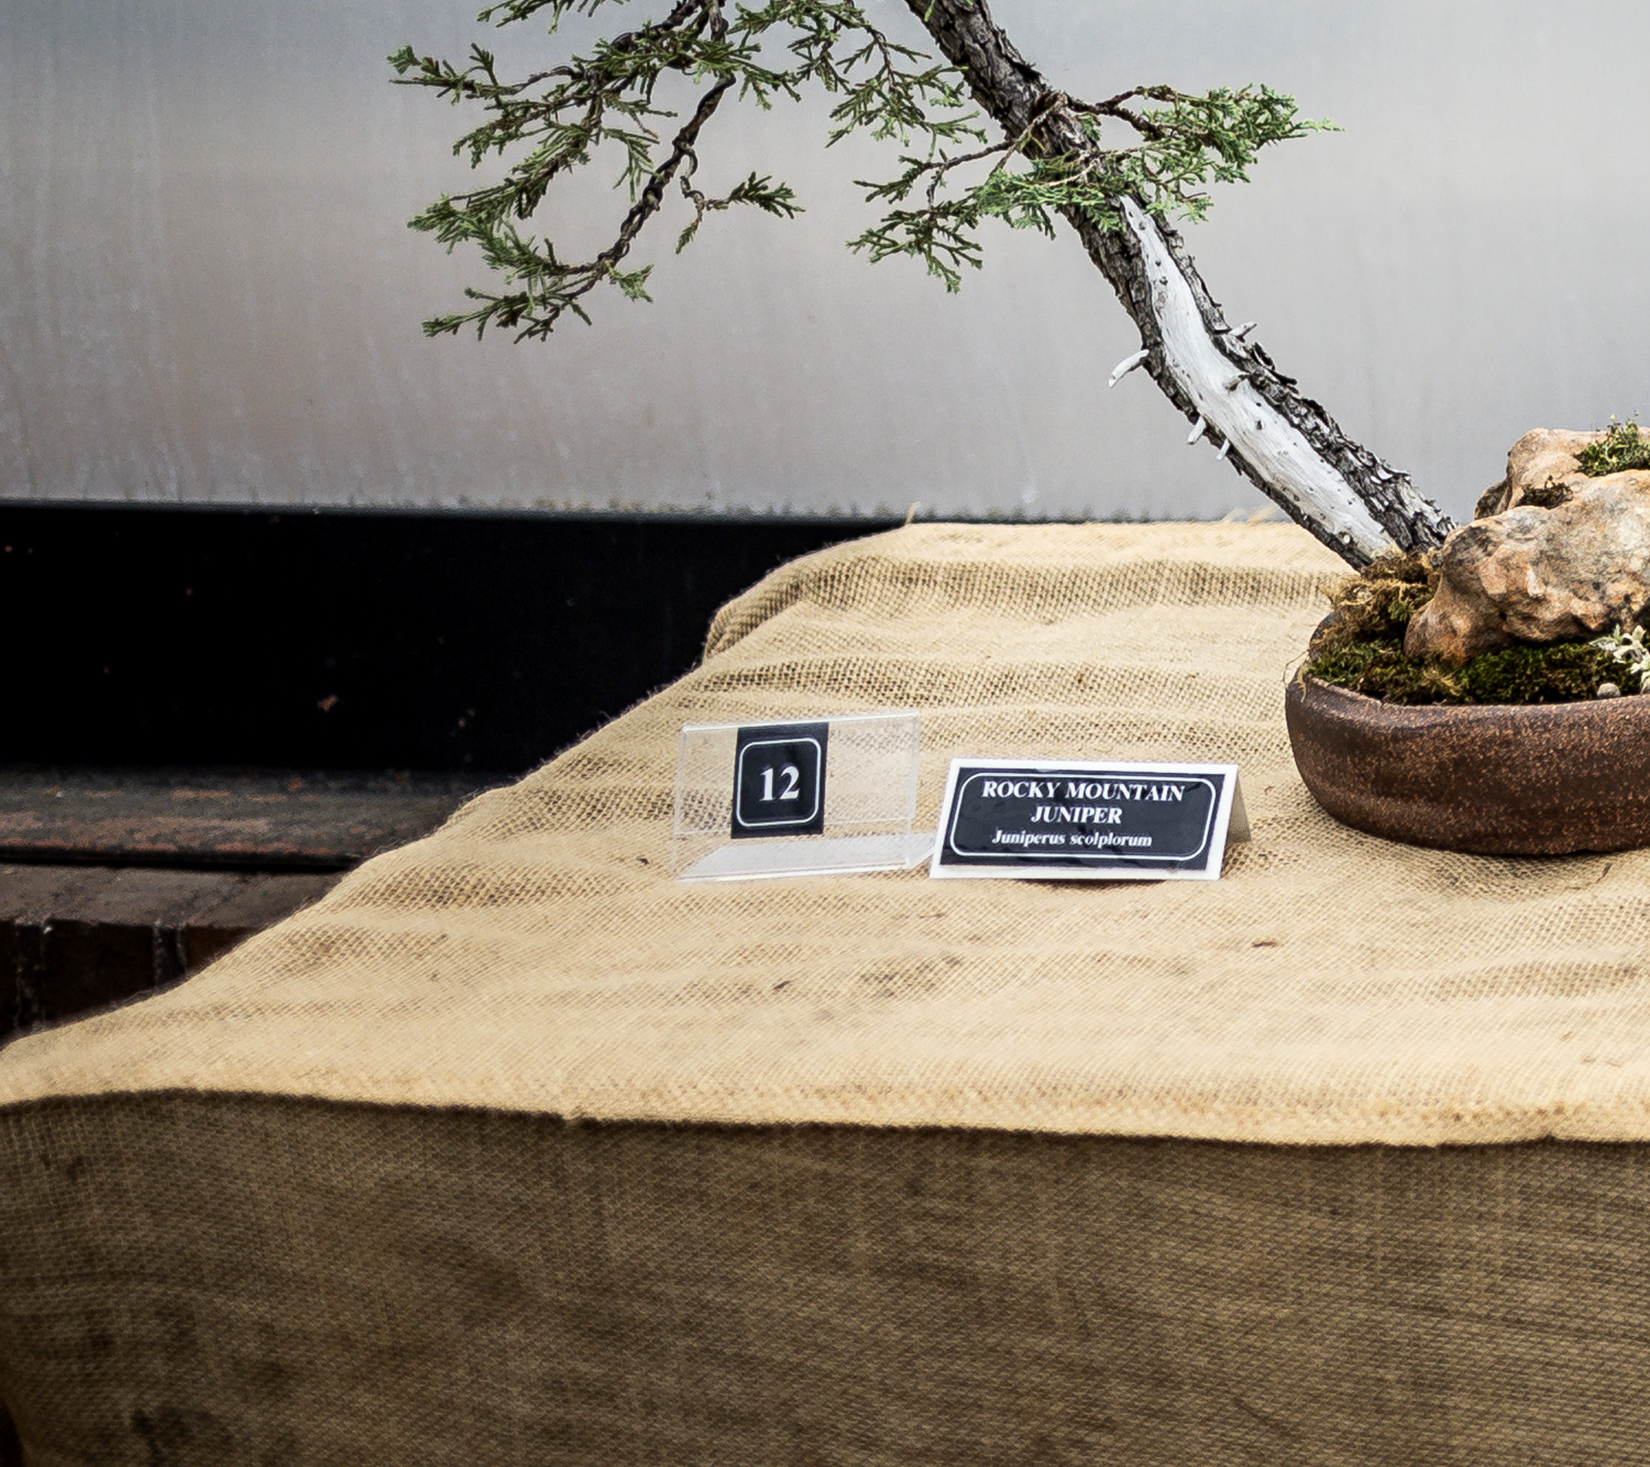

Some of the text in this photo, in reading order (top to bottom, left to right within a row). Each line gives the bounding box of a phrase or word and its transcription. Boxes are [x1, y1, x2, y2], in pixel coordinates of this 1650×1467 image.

[759, 766, 800, 802] 12
[981, 780, 1185, 802] ROCKY MOUNTAIN
[1031, 806, 1123, 824] JUNIPER
[992, 829, 1065, 847] Juniperus
